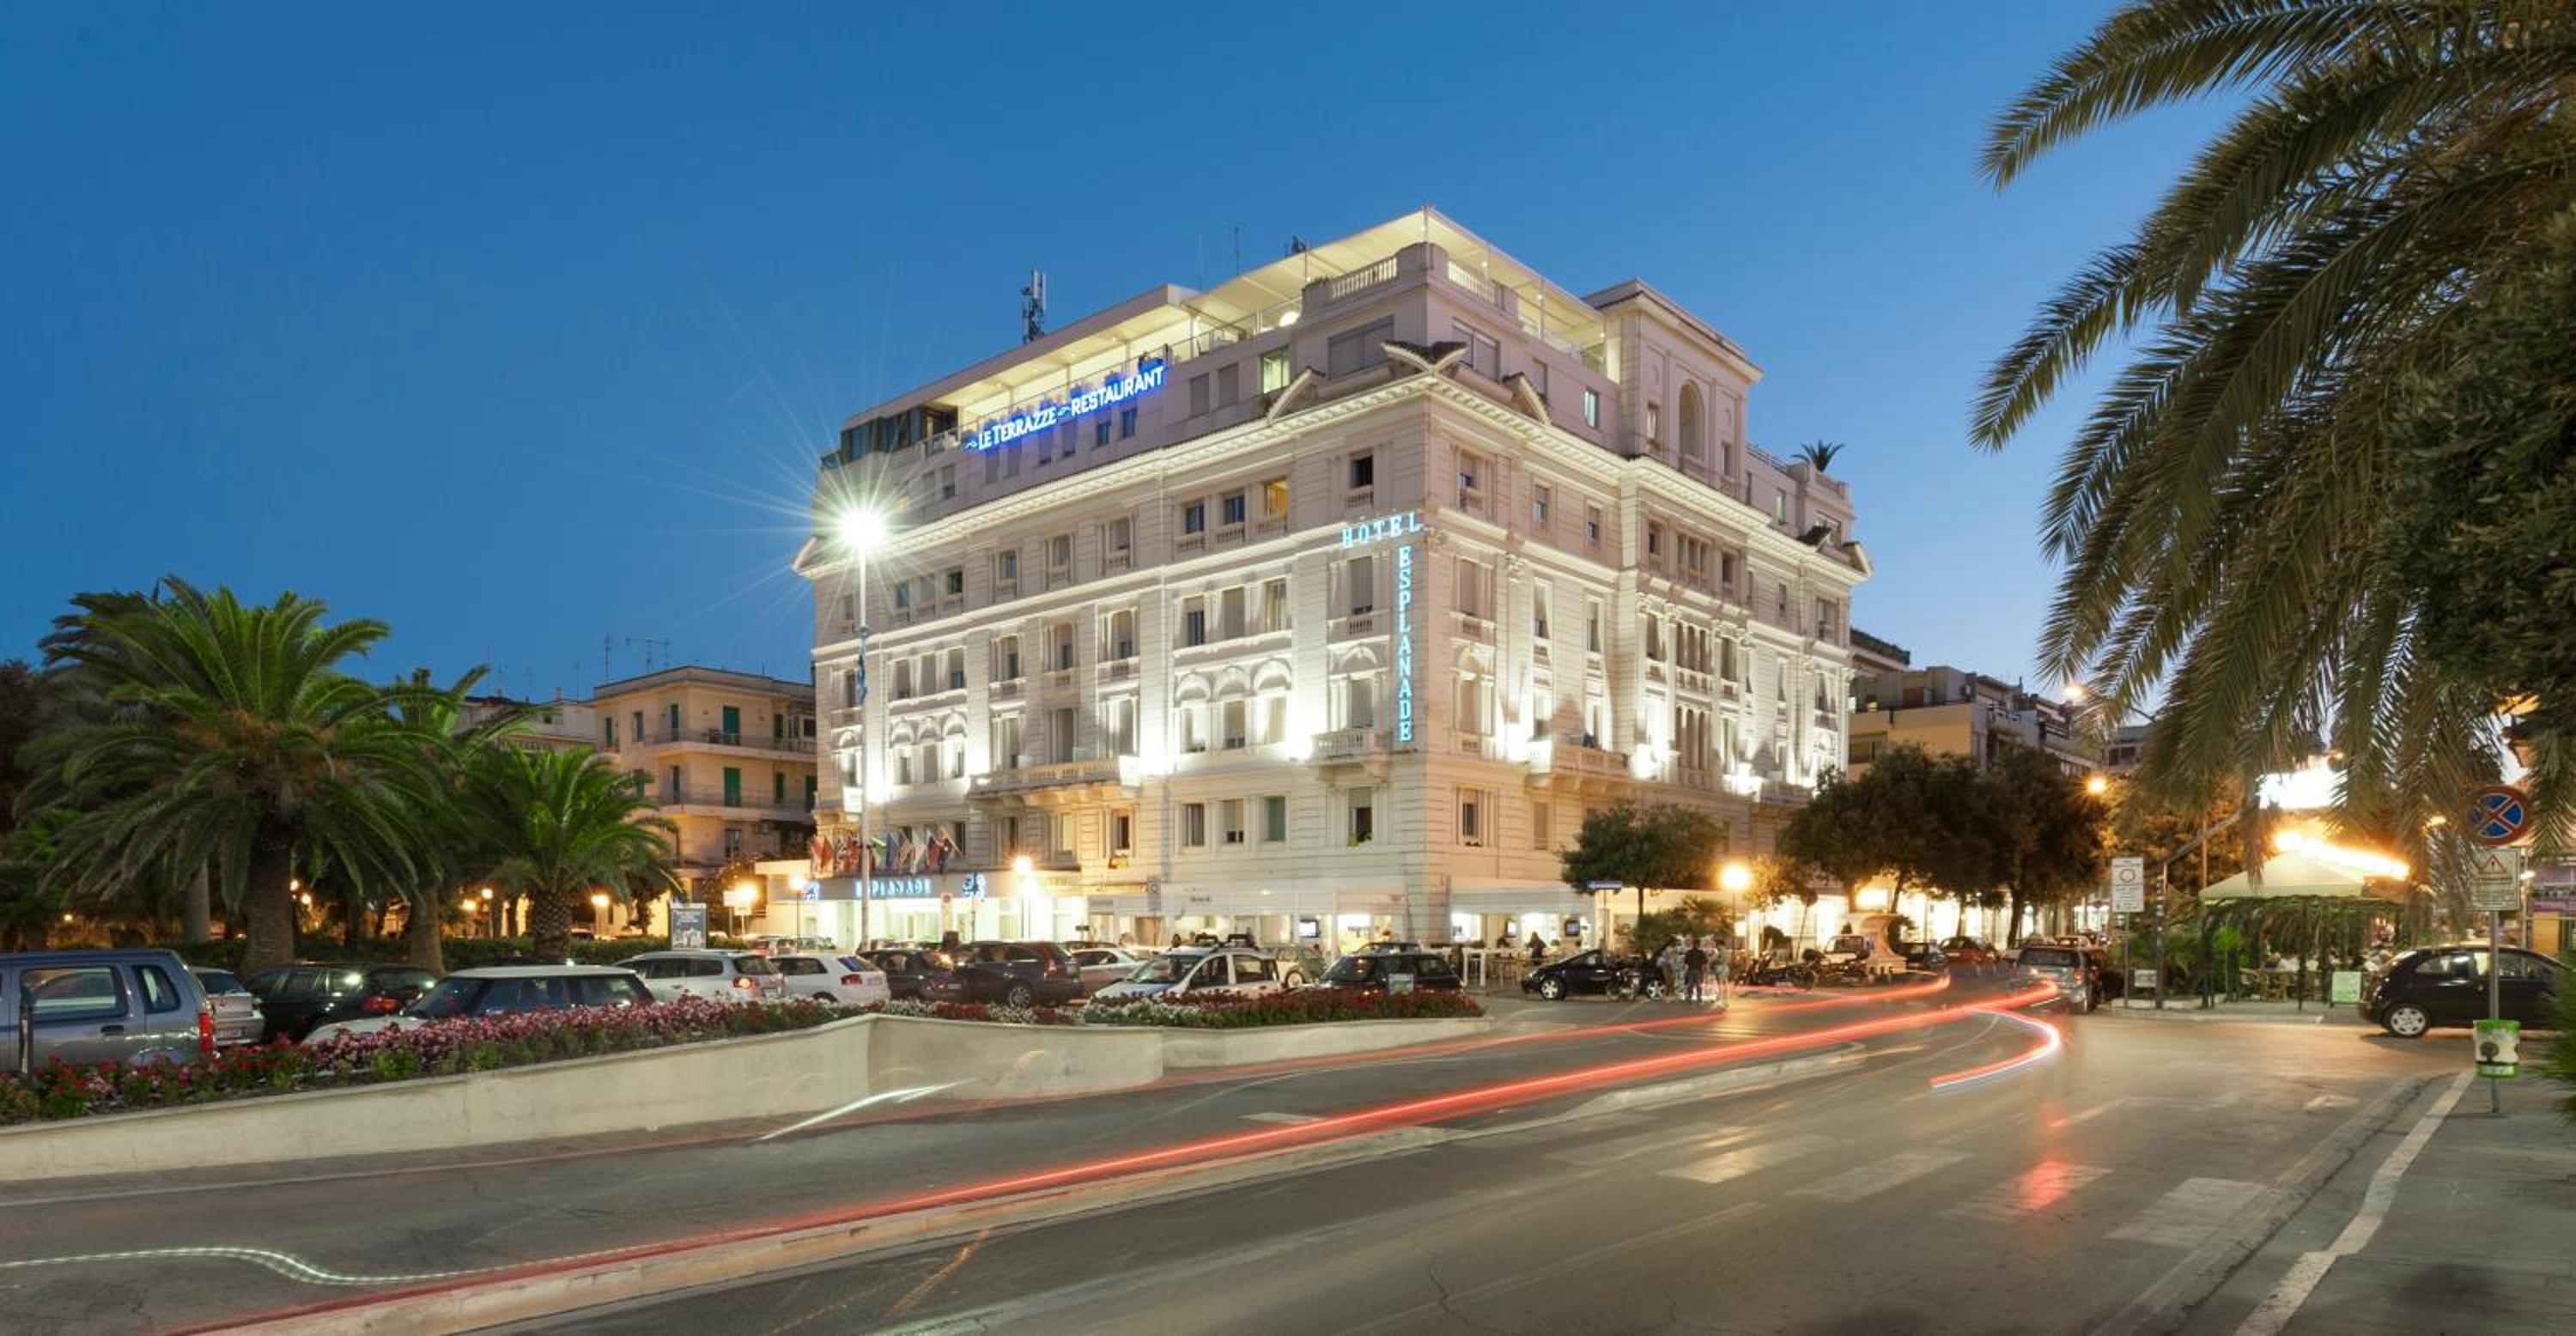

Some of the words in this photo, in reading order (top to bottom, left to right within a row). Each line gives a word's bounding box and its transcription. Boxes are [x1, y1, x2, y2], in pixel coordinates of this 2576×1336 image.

[978, 431, 991, 450] LE
[992, 407, 1056, 445] TERRAZZE
[1072, 366, 1164, 416] RESTAURANT
[1342, 512, 1424, 549] HOTEL
[1399, 545, 1413, 742] ESPLANADE
[855, 878, 932, 897] EPLANADE
